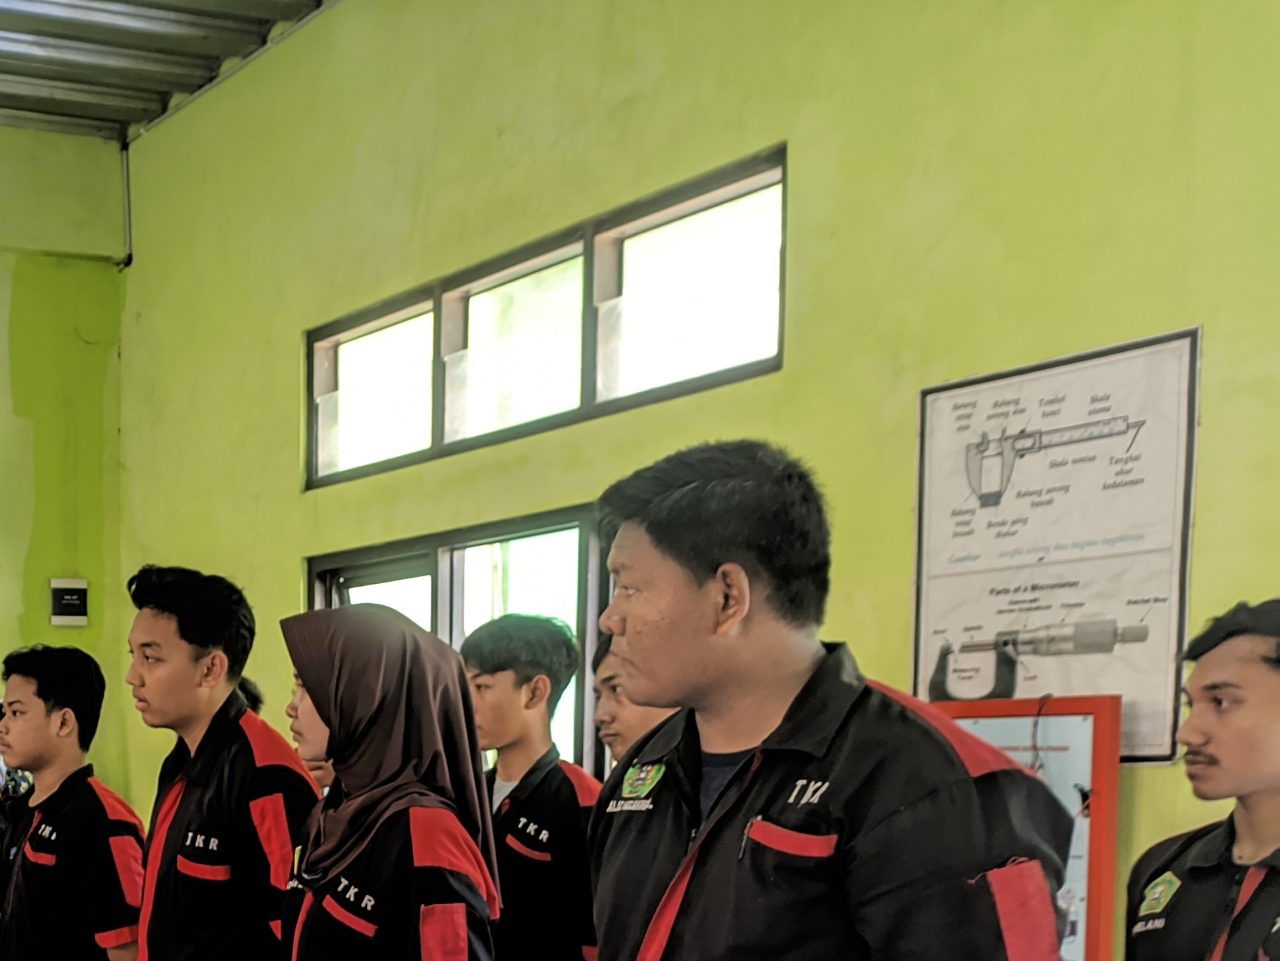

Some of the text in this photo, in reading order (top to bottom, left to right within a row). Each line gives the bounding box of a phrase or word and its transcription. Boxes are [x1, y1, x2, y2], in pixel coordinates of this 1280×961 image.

[185, 832, 219, 851] TKR
[517, 817, 550, 843] TKR
[338, 877, 375, 911] TKR
